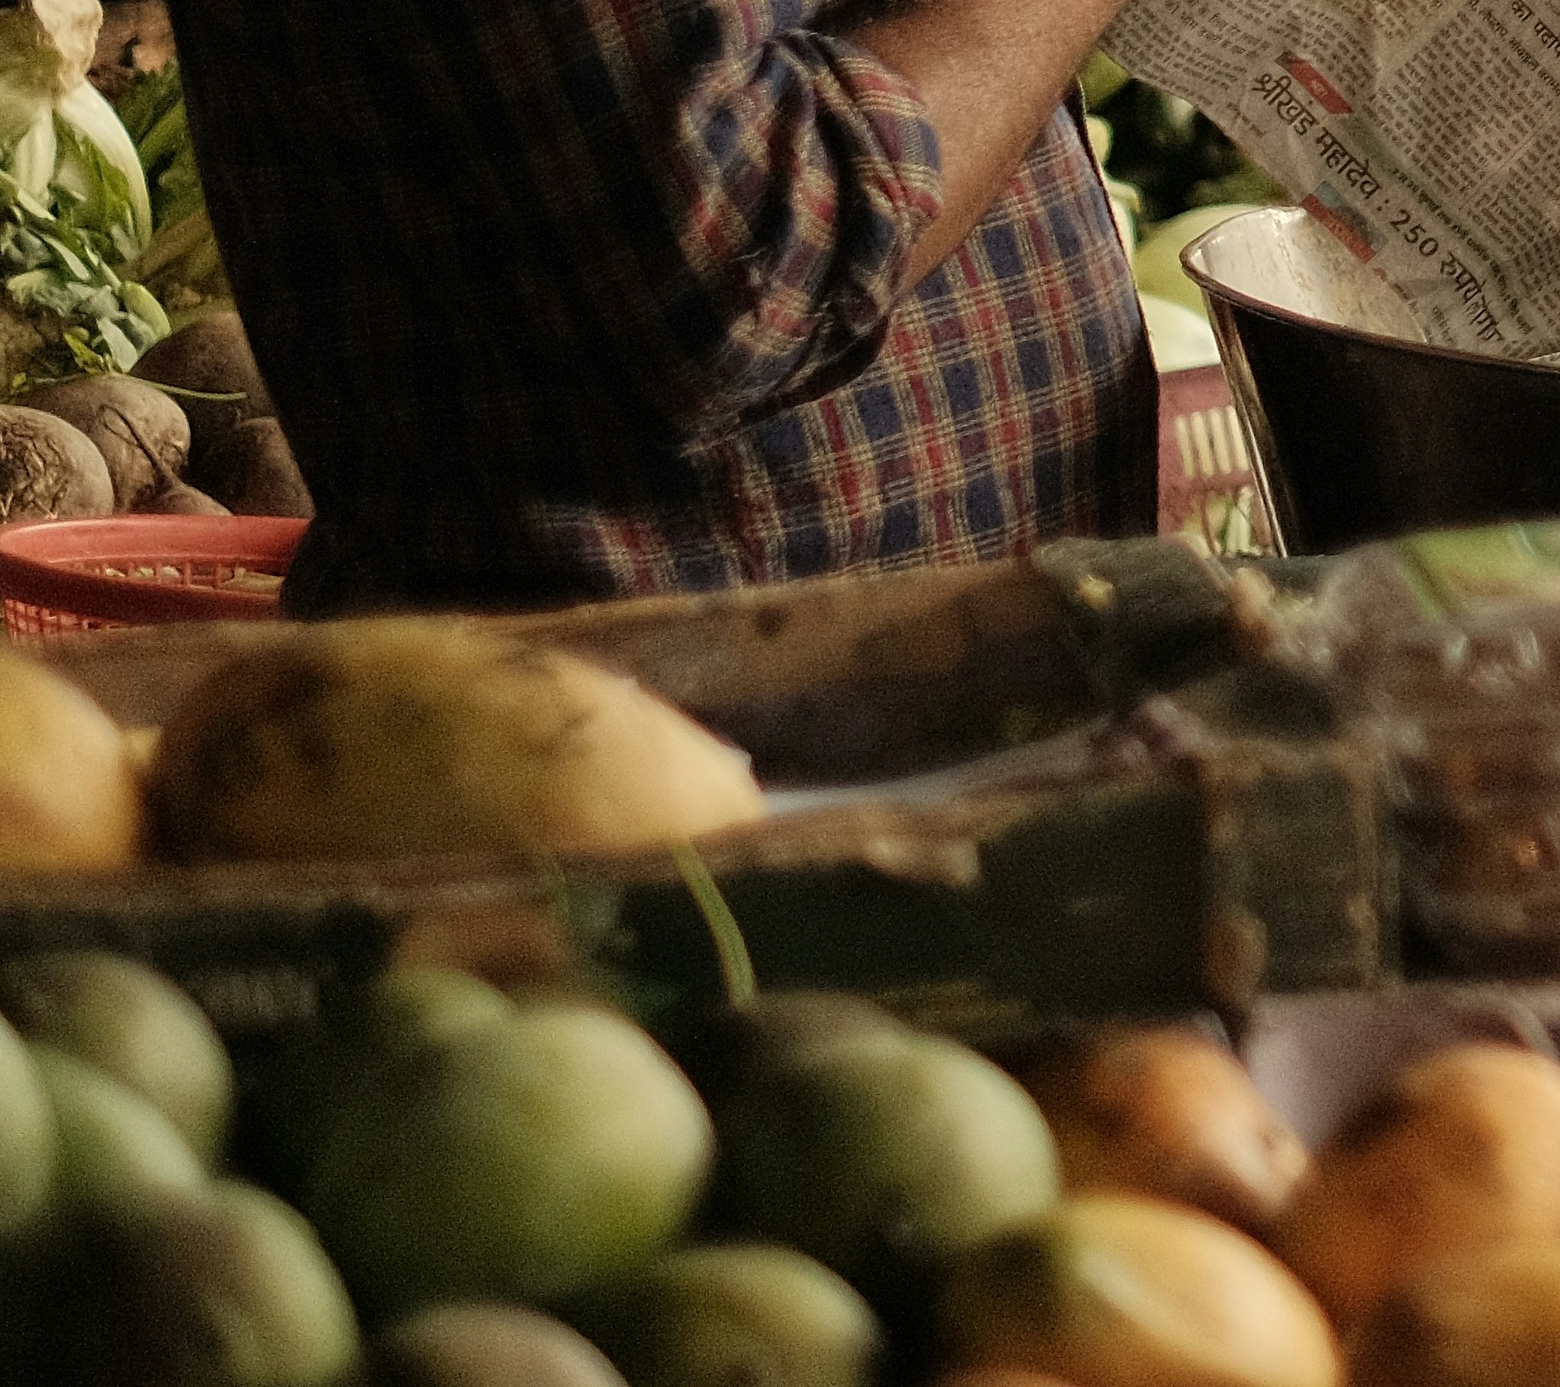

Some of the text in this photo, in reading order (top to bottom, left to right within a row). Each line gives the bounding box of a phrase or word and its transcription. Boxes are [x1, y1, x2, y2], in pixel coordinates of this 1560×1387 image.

[1508, 36, 1540, 72] मोबाइल
[1250, 58, 1319, 137] श्रीखंड
[1314, 126, 1383, 201] महादेव
[1389, 208, 1439, 258] 250
[1439, 251, 1487, 305] रुपये
